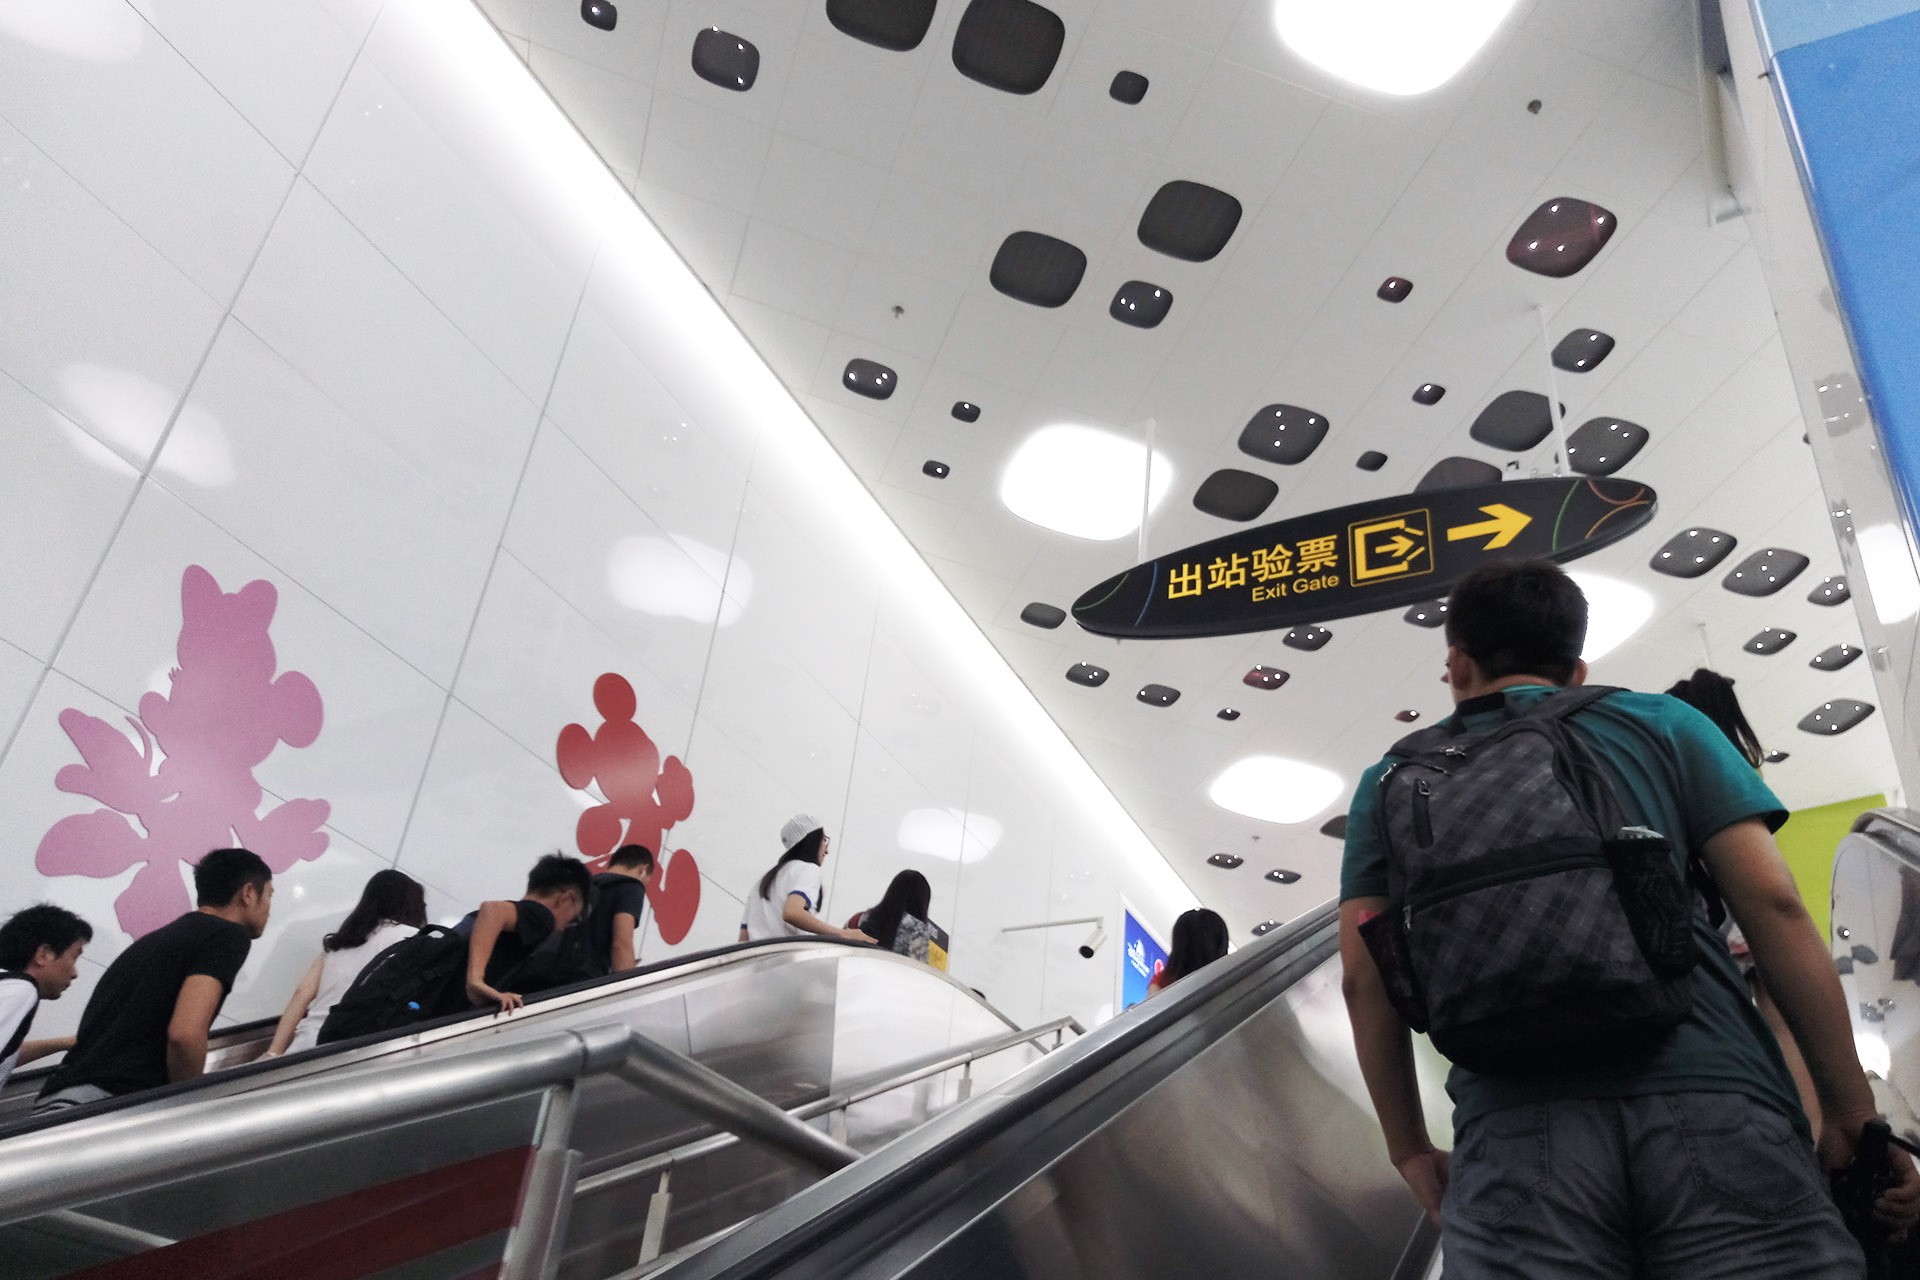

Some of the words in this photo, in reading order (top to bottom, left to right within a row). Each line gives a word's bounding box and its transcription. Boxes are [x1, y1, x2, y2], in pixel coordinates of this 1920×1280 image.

[1168, 534, 1339, 599] 出站验票
[1252, 582, 1288, 602] Exit
[1292, 575, 1340, 594] Gate
